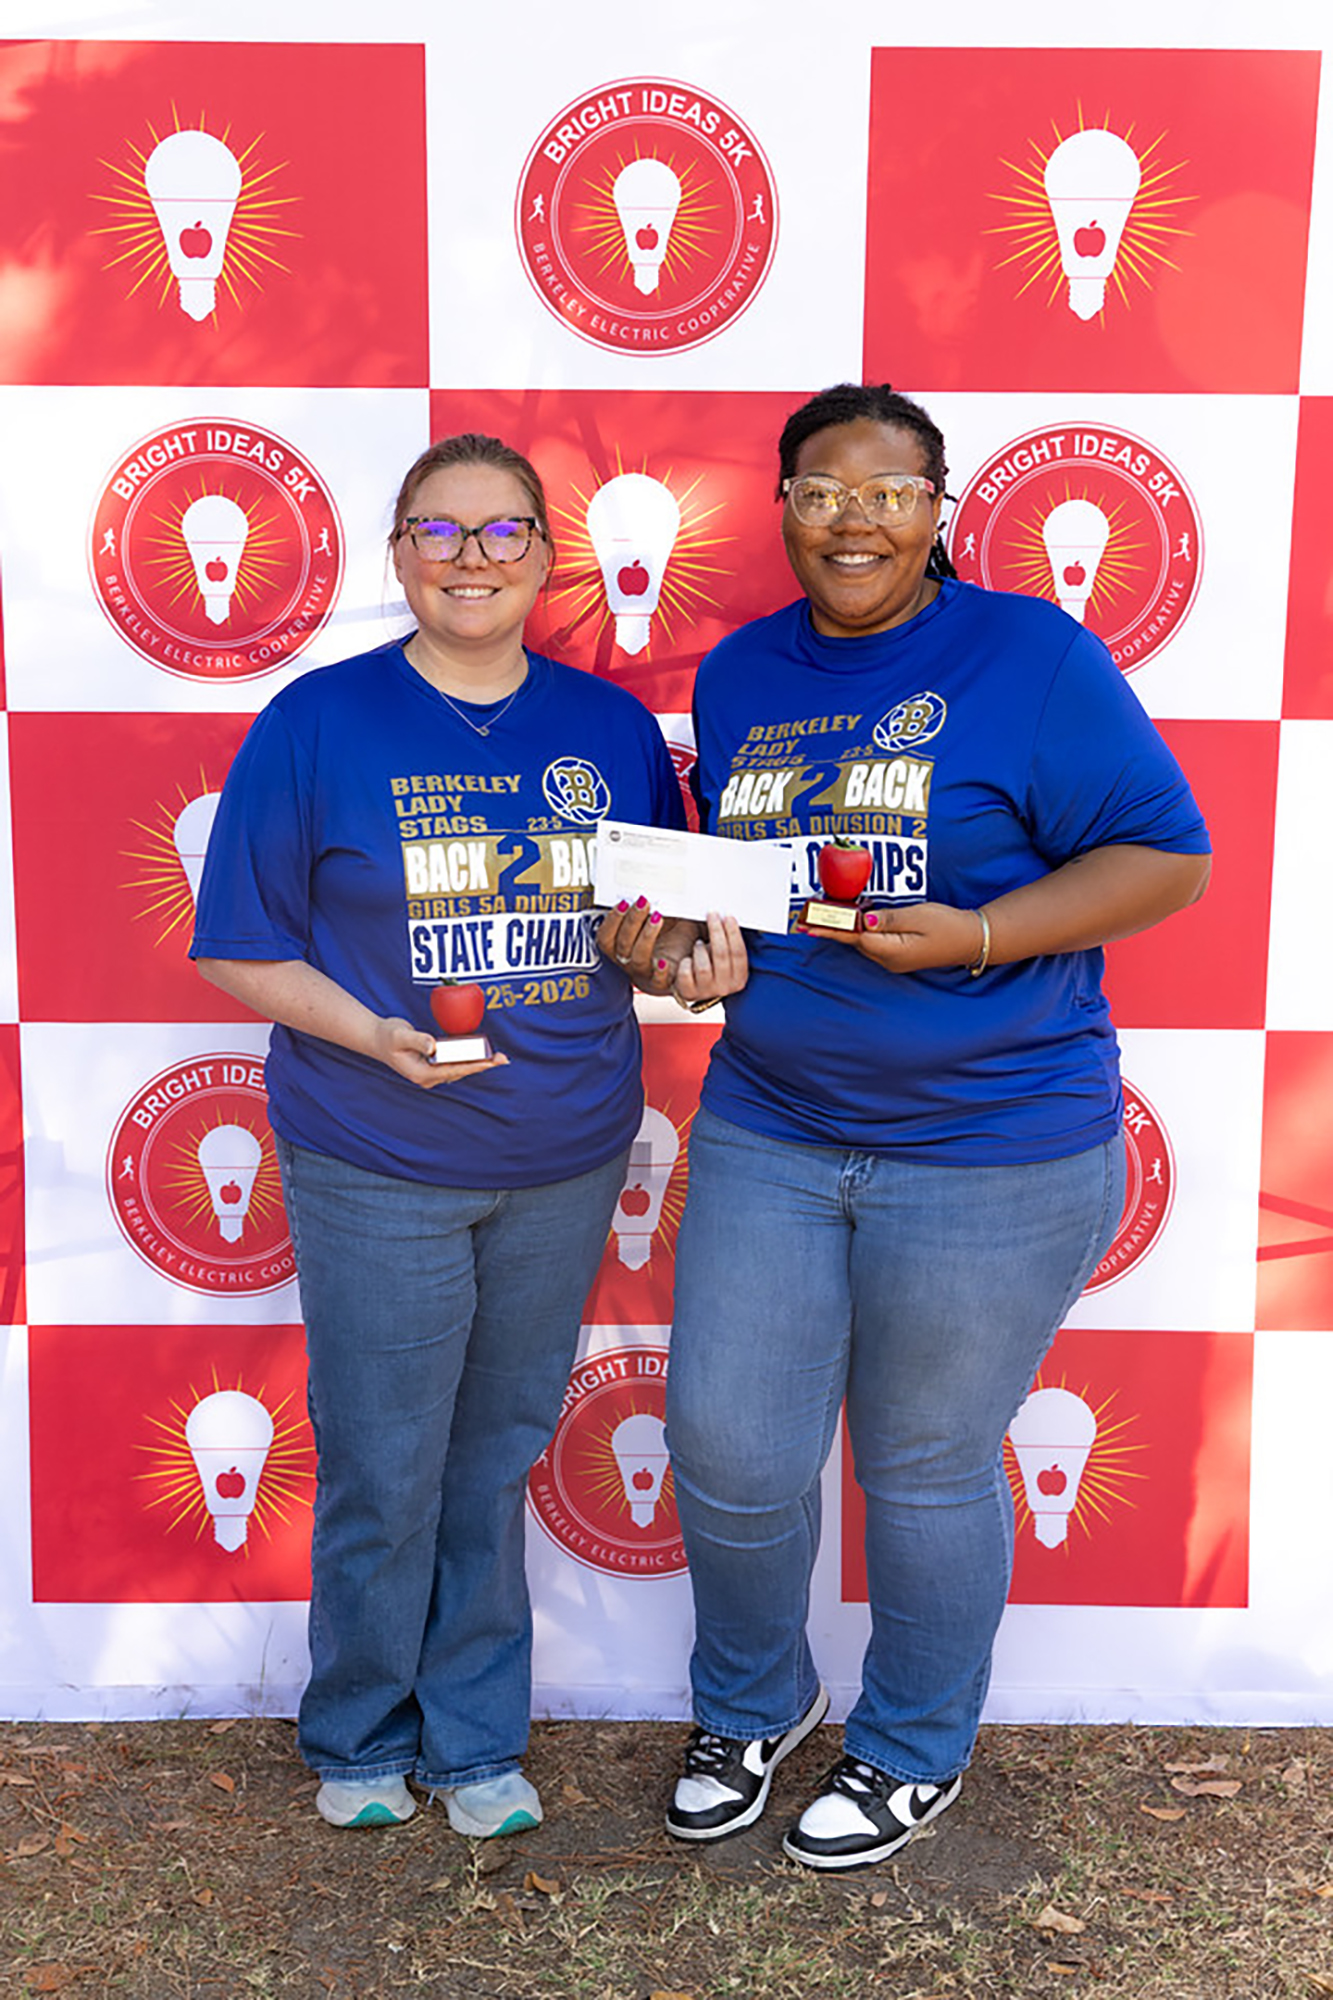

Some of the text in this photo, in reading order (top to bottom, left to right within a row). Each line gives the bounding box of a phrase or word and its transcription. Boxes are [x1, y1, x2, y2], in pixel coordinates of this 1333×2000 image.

[543, 90, 753, 167] BRIGHT IDEAS 5K
[533, 243, 760, 340] BERKELEY ELECTRIC COOPERATIVE
[111, 430, 317, 503] BRIGHT IDEAS 5K
[976, 434, 1181, 507] BRIGHT IDEAS 5K
[105, 575, 327, 668] BERKELEY ELECTRIC COOPERATIVE
[1111, 580, 1184, 664] OOPERATIVE
[737, 739, 800, 756] LADY
[747, 714, 863, 742] BERKELEY
[390, 774, 522, 796] BERKELEY
[719, 759, 931, 819] BACK 2 BACK
[731, 754, 806, 769] STAGS
[395, 795, 463, 817] LADY
[399, 816, 488, 838] STAGS
[717, 820, 767, 841] GIRLS
[810, 814, 903, 836] DIVISION
[912, 820, 928, 839] 2
[404, 841, 490, 895] BACK
[496, 834, 542, 899] 2
[407, 899, 471, 919] GIRLS
[412, 920, 494, 974] STATE
[486, 974, 591, 1010] 25-2026
[132, 1064, 266, 1129] BRIGHT IDE
[1122, 1102, 1152, 1136] 5K
[123, 1198, 176, 1264] BERKELEY
[179, 1262, 255, 1283] ELECTRIC
[1092, 1201, 1158, 1278] OPERATIVE
[537, 1484, 665, 1567] BERKELEY ELECTRIC
